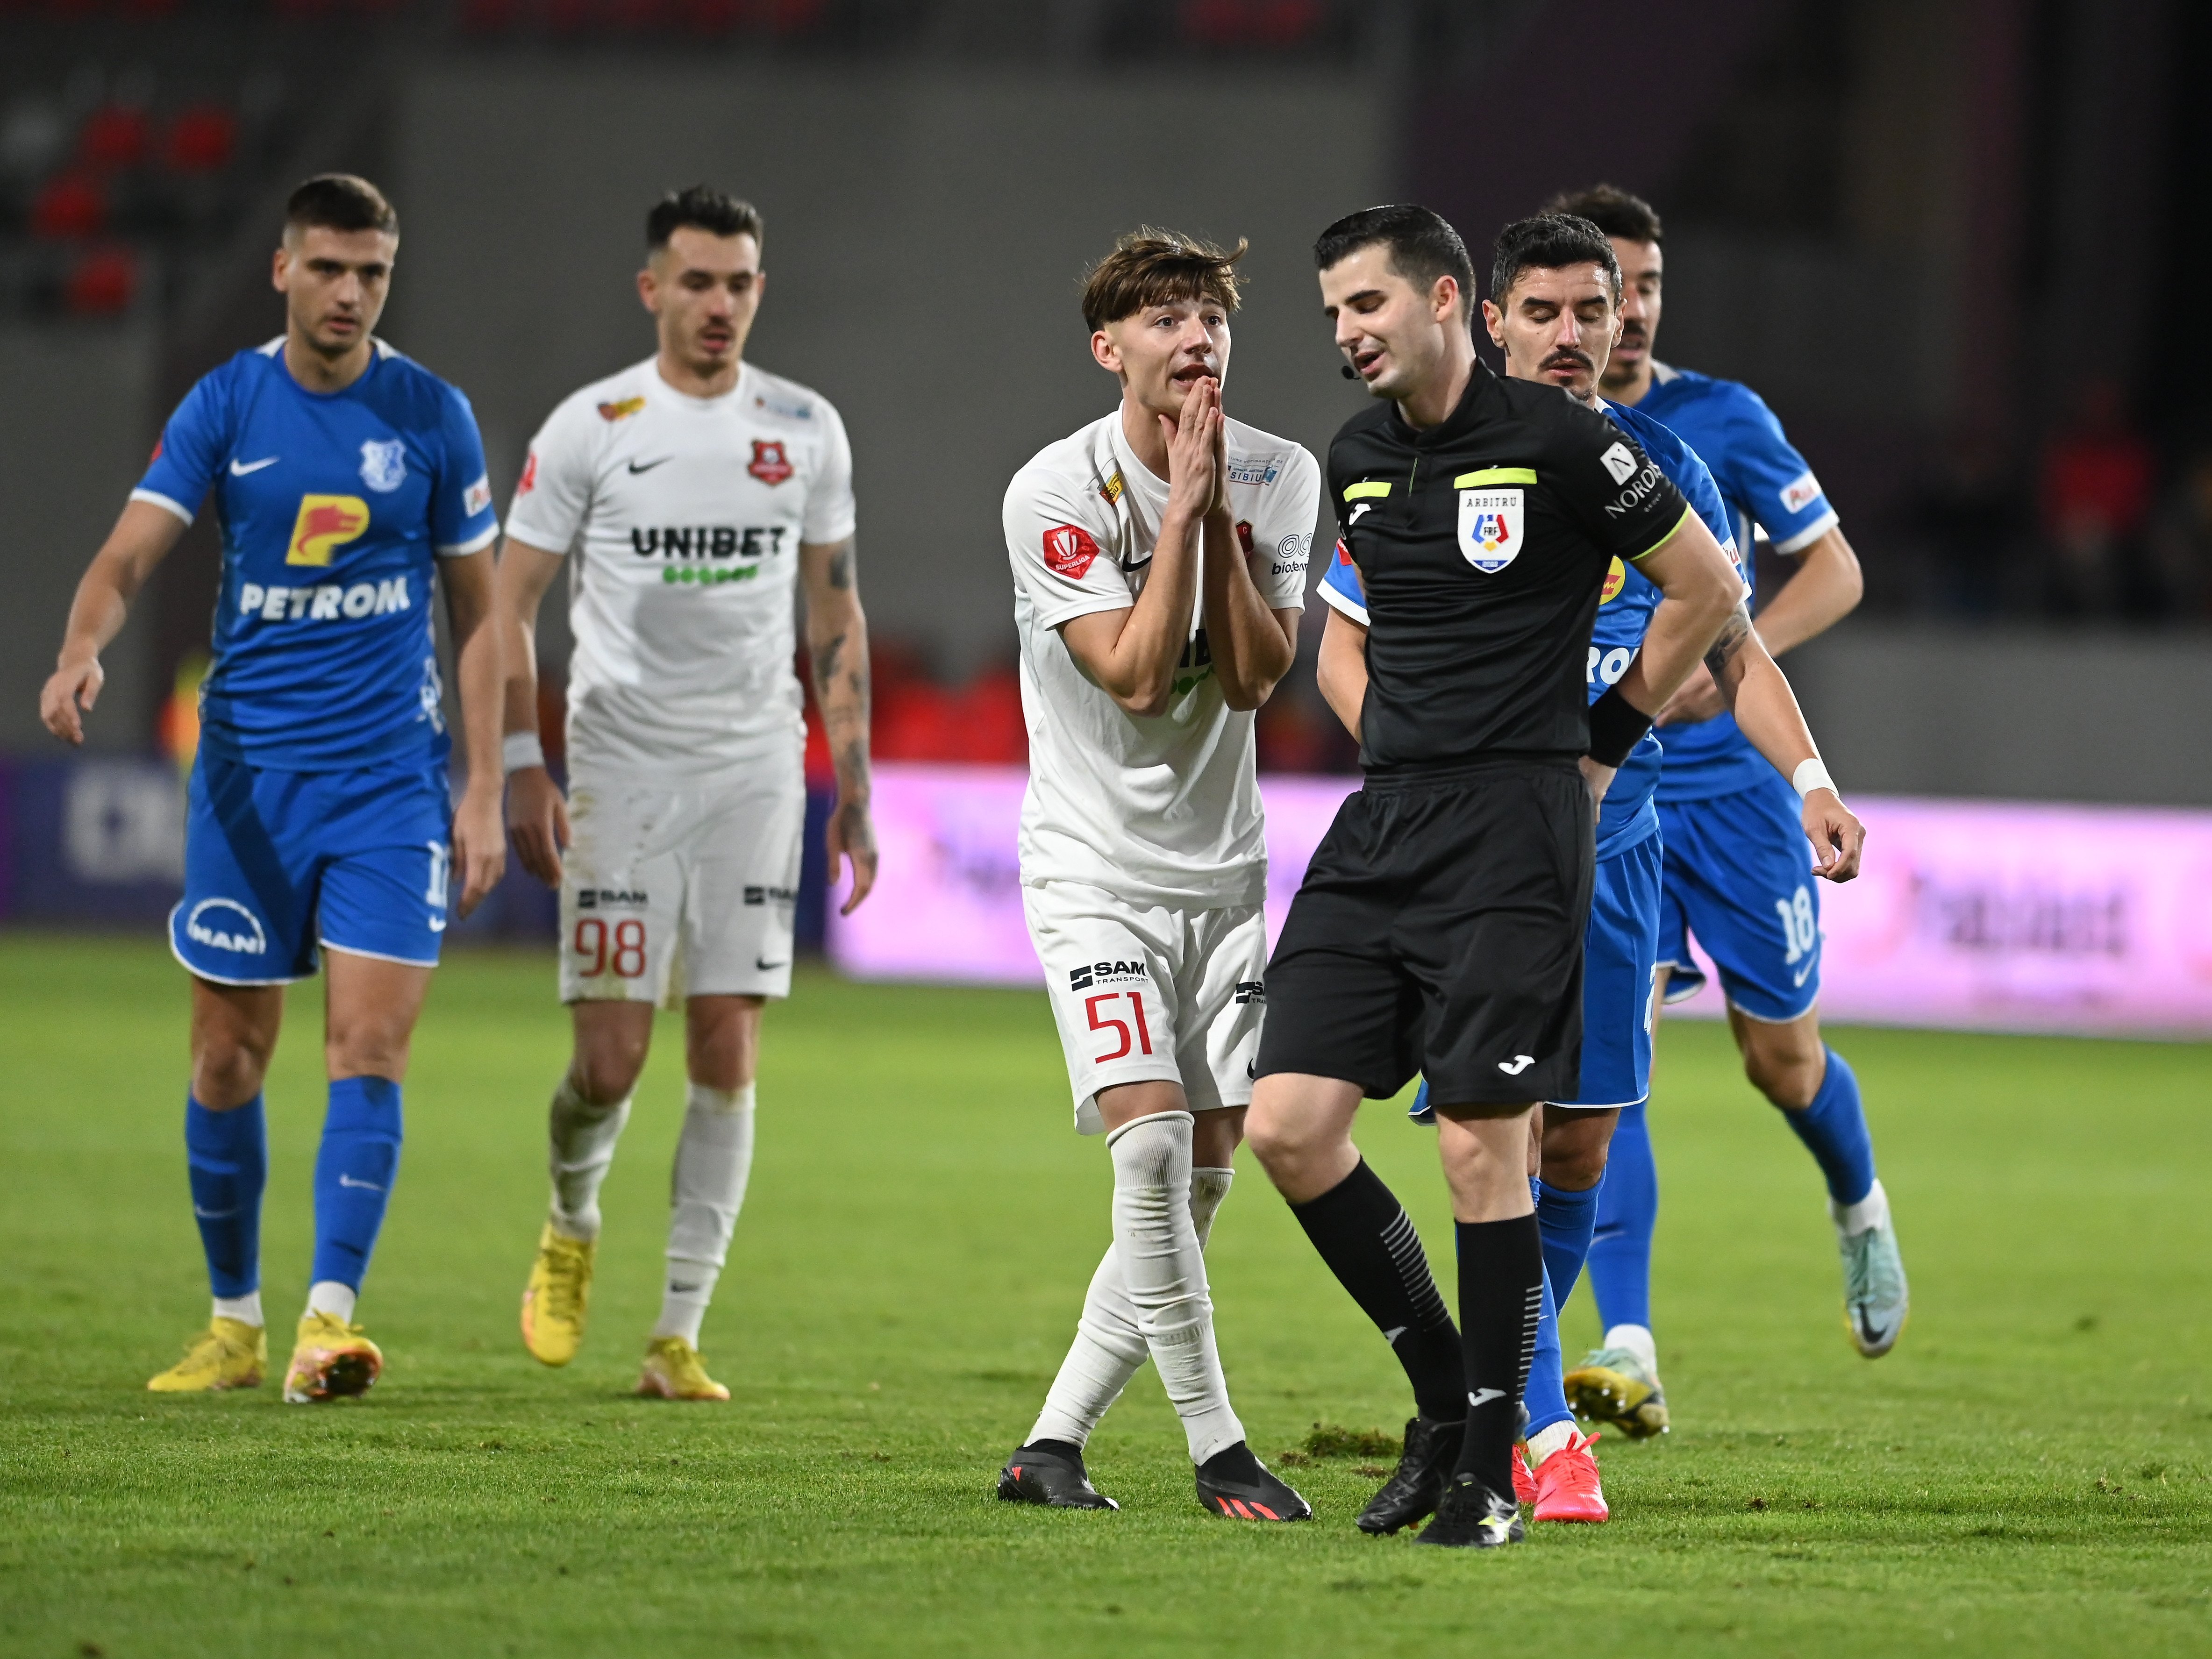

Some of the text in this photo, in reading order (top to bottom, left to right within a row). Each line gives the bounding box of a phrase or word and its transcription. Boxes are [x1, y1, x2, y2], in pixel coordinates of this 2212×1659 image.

[1230, 472, 1262, 482] SIBIU
[1466, 497, 1517, 507] ARBITRU
[631, 527, 787, 559] UNIBET
[1056, 555, 1091, 570] SUPERLIGA
[240, 576, 410, 621] PETROM
[191, 924, 258, 954] MAN
[1776, 885, 1815, 966] 18
[575, 918, 646, 978] 98
[1094, 961, 1146, 976] SAM
[1096, 976, 1149, 985] TRANSPORT
[1085, 991, 1153, 1064] 51
